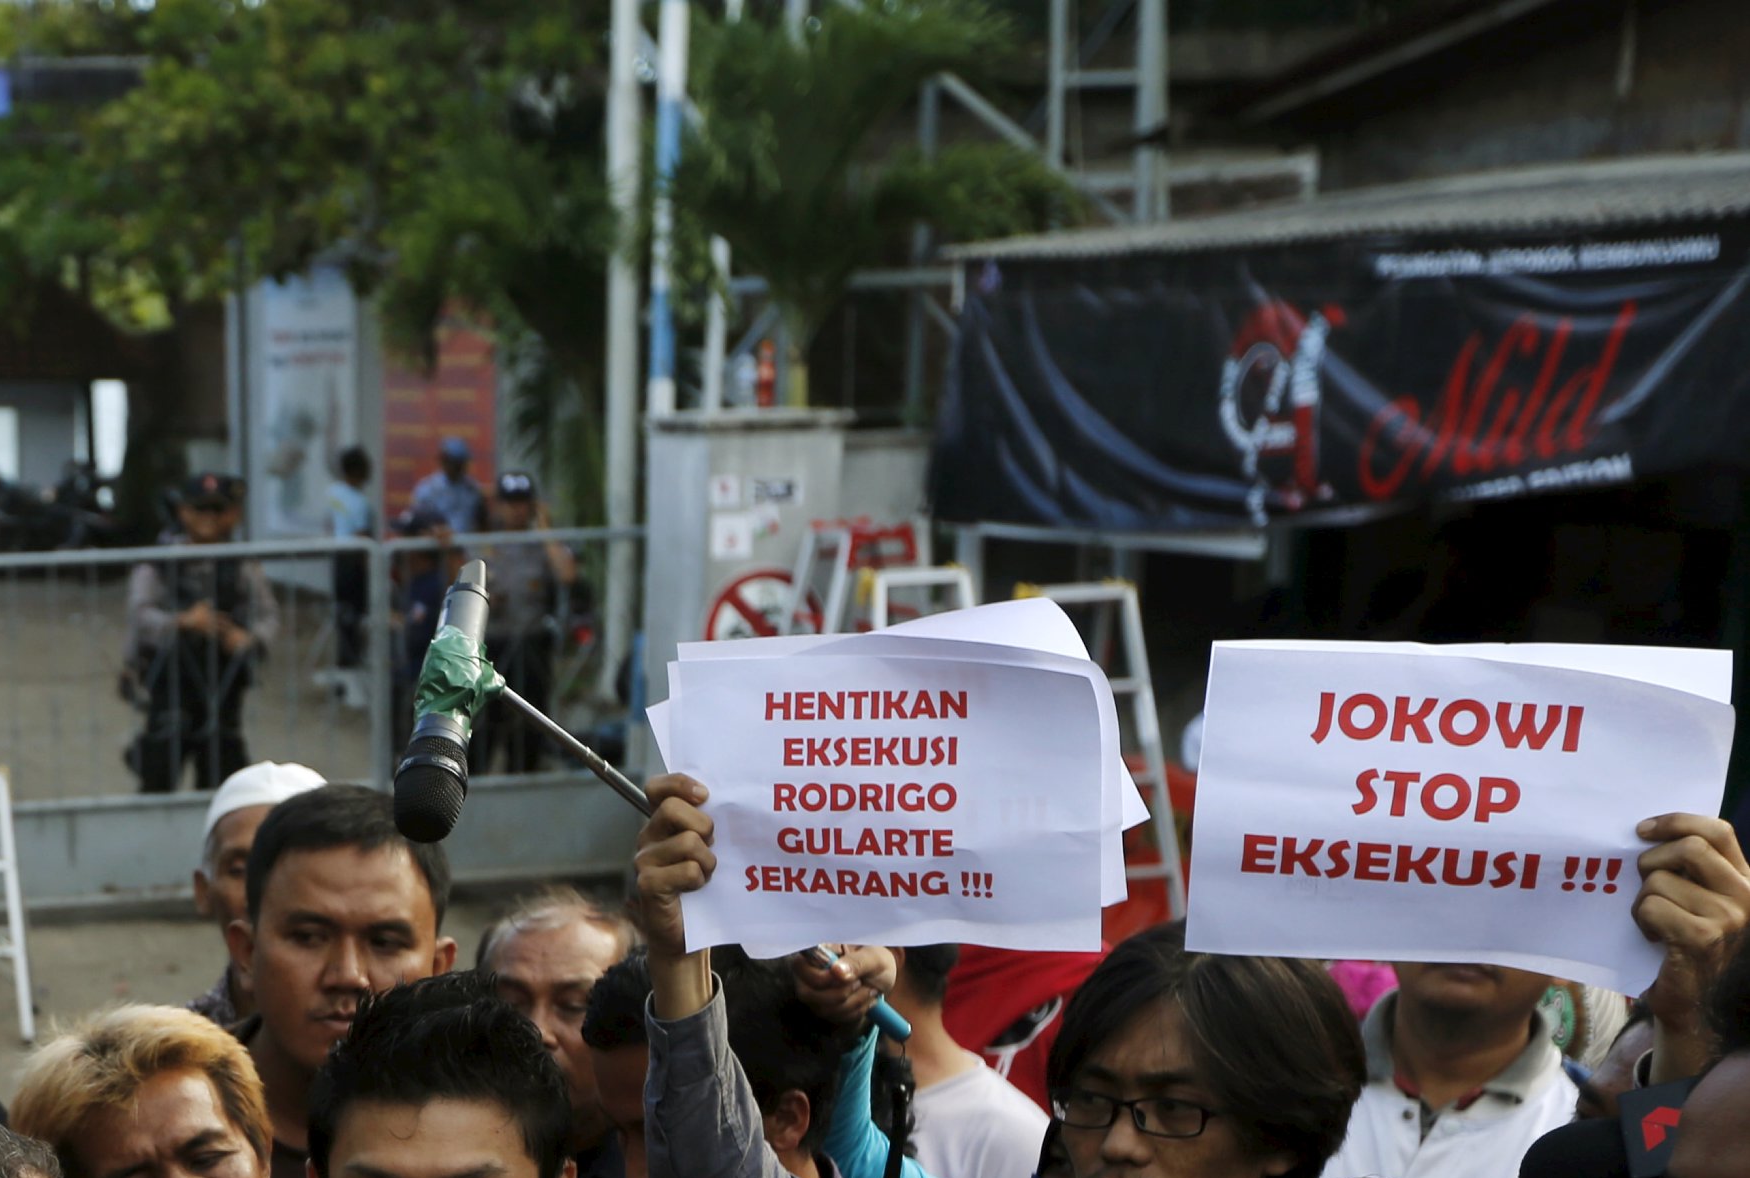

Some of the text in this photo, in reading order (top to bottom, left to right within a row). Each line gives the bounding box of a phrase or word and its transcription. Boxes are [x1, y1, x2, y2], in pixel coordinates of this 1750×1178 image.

[1358, 298, 1638, 500] Mild
[767, 692, 966, 720] HENTIKAN
[1313, 693, 1582, 751] JOKOWI
[785, 738, 956, 765] EKSEKUSI
[775, 784, 956, 811] RODRIGO
[1354, 770, 1519, 822] STOP
[779, 829, 951, 855] GULARTE
[1243, 835, 1622, 895] EKSEKUSI !!!
[747, 867, 994, 899] SEKARANG !!!
